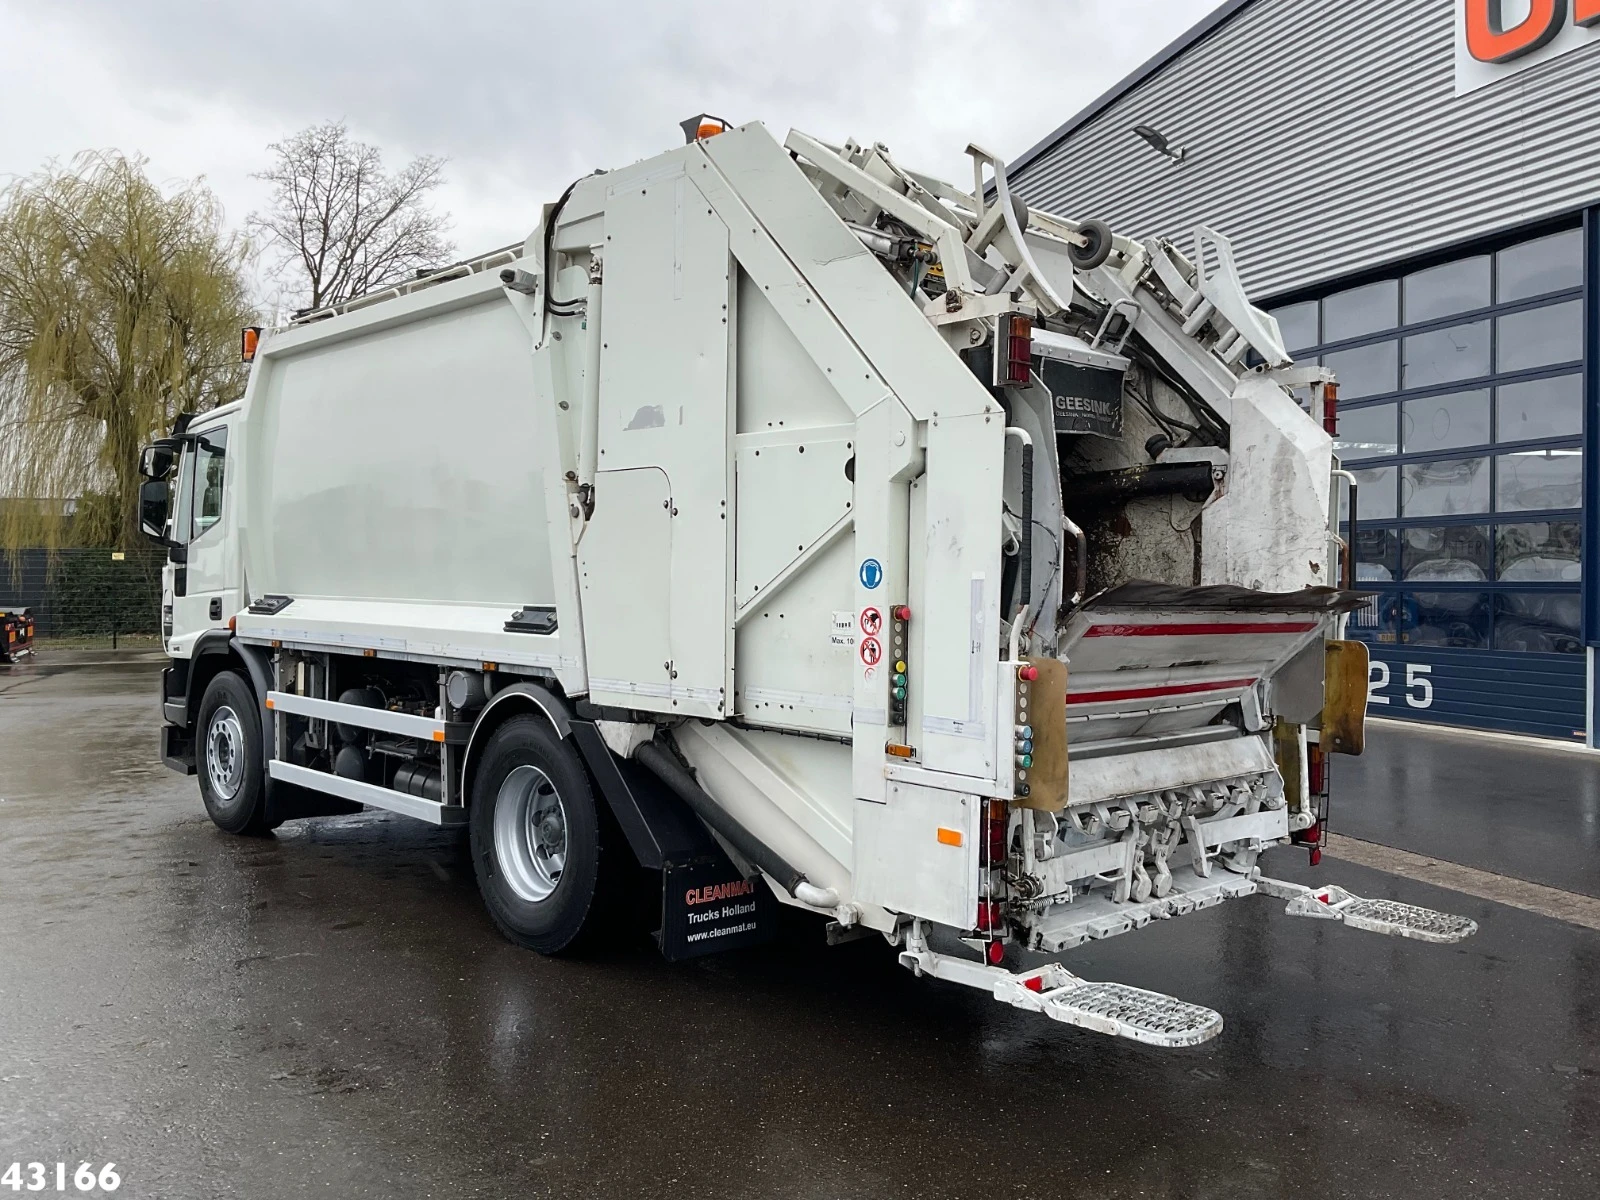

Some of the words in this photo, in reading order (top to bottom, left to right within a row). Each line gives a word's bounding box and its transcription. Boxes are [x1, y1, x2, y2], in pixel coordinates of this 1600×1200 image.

[1055, 395, 1112, 416] GEESINK
[687, 909, 720, 925] Trucks
[722, 900, 756, 918] Holland
[687, 922, 757, 943] www.cleanmat.eu
